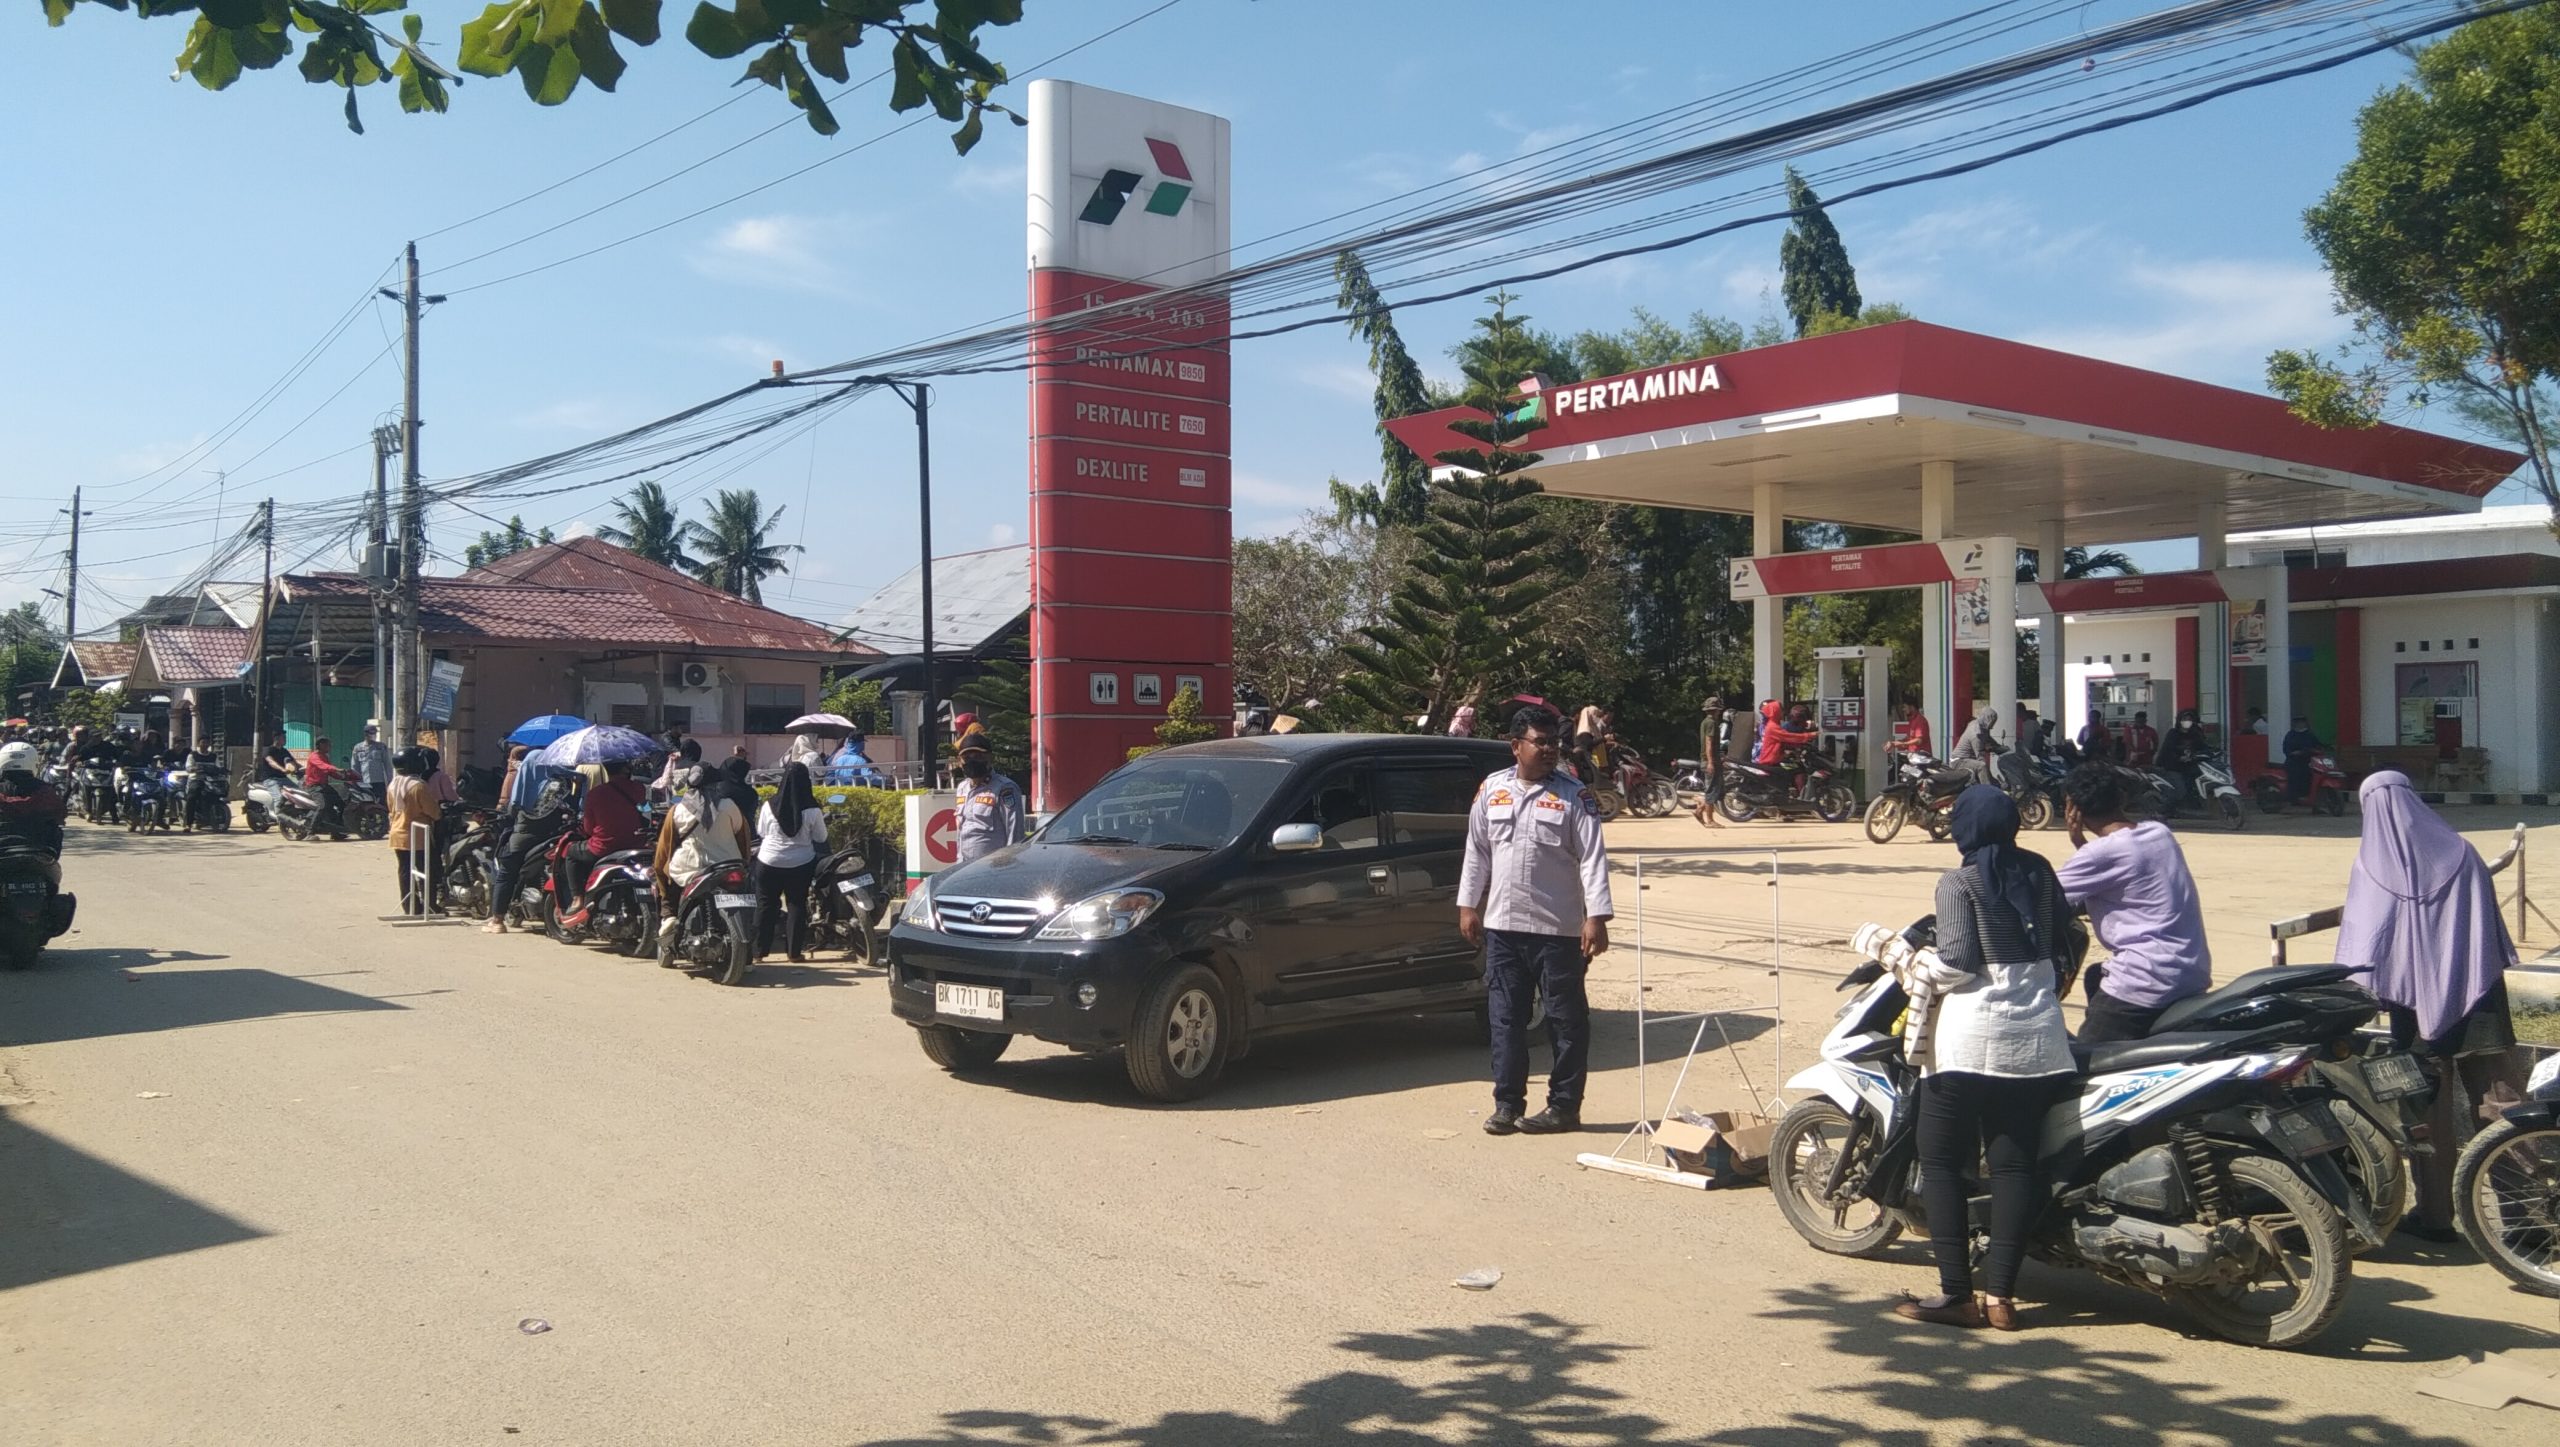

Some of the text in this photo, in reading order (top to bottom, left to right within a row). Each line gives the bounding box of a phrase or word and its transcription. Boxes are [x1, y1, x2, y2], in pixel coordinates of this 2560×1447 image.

[1076, 346, 1204, 380] PERTAMAX 9850
[1555, 364, 1720, 416] PERTAMINA
[1076, 401, 1204, 433] PERTALITE 7650
[1076, 457, 1149, 483] DEXLITE
[1831, 553, 1863, 562] PERTAMAX
[1831, 562, 1862, 572] PERTALITE
[938, 985, 1000, 1010] BK 1711 AG
